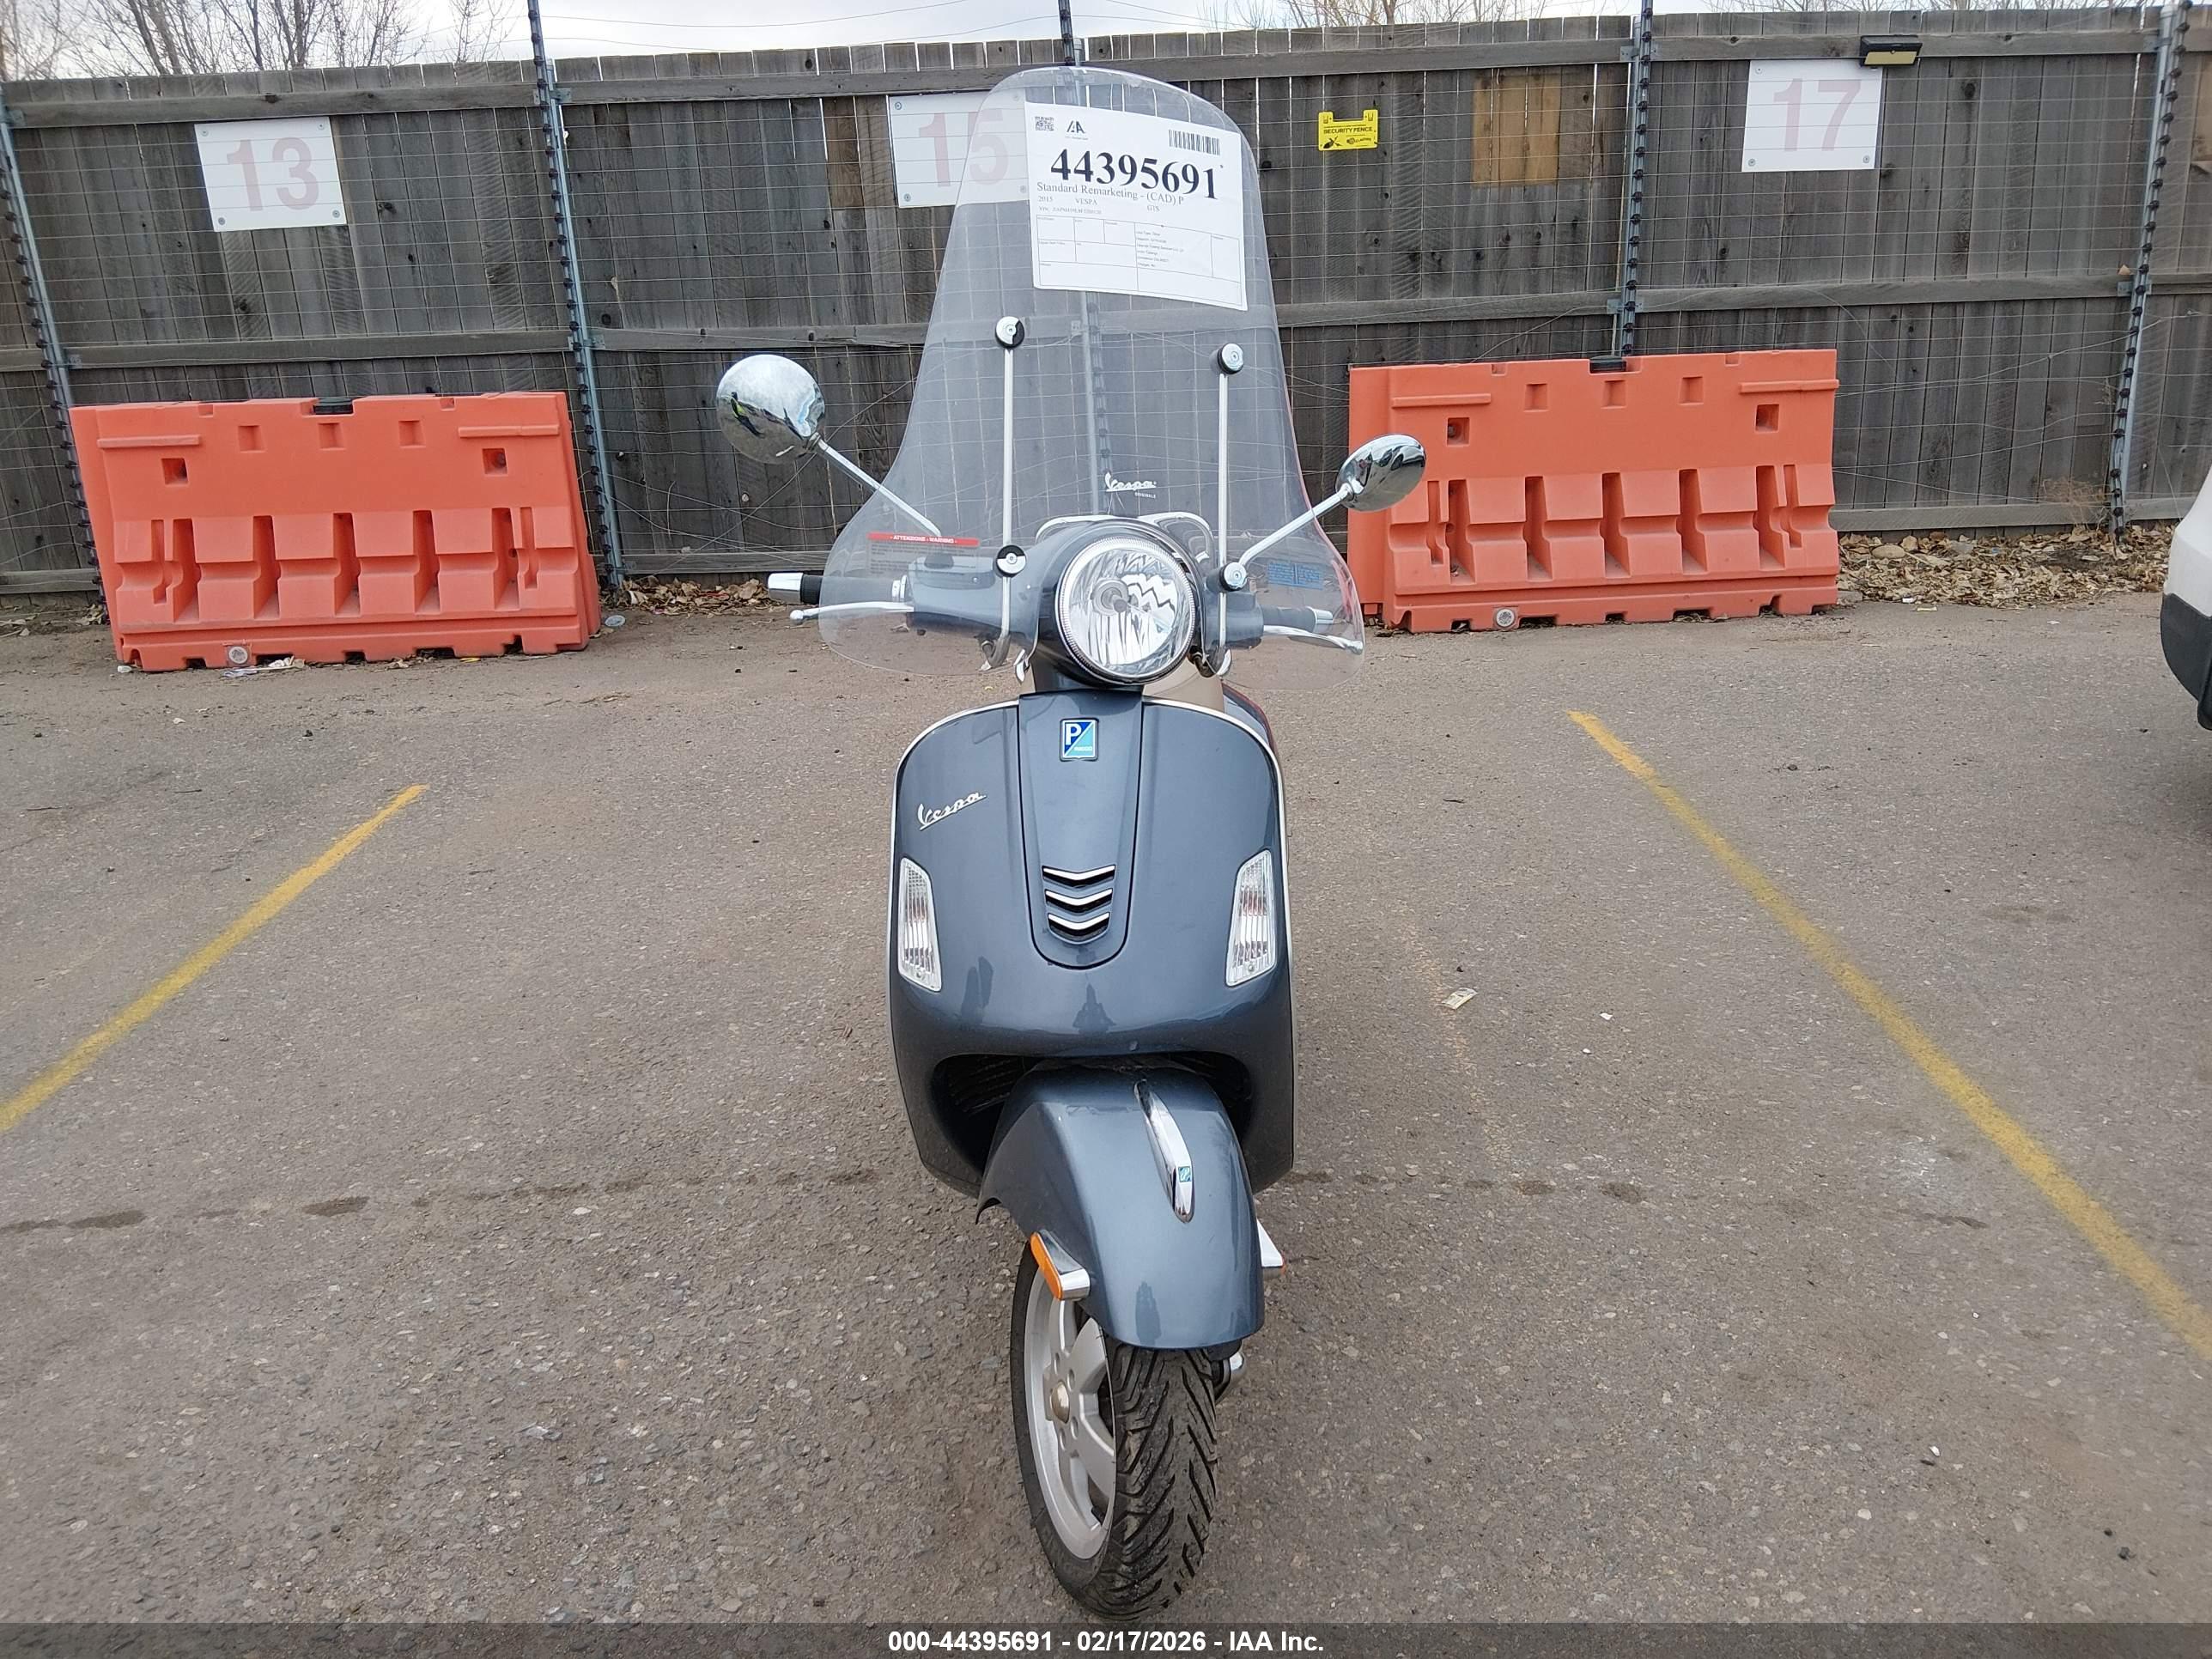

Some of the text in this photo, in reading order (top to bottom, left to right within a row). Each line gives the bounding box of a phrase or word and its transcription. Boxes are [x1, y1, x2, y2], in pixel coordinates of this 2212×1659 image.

[1773, 78, 1862, 152] 17
[918, 108, 1009, 186] 15
[226, 137, 319, 211] 13
[1036, 181, 1078, 193] Standard
[1081, 185, 1139, 201] Remarketing
[1146, 191, 1176, 206] (CAD)
[1050, 148, 1218, 200] 44395691
[1104, 472, 1157, 492] Vespa
[917, 792, 987, 832] Vespa
